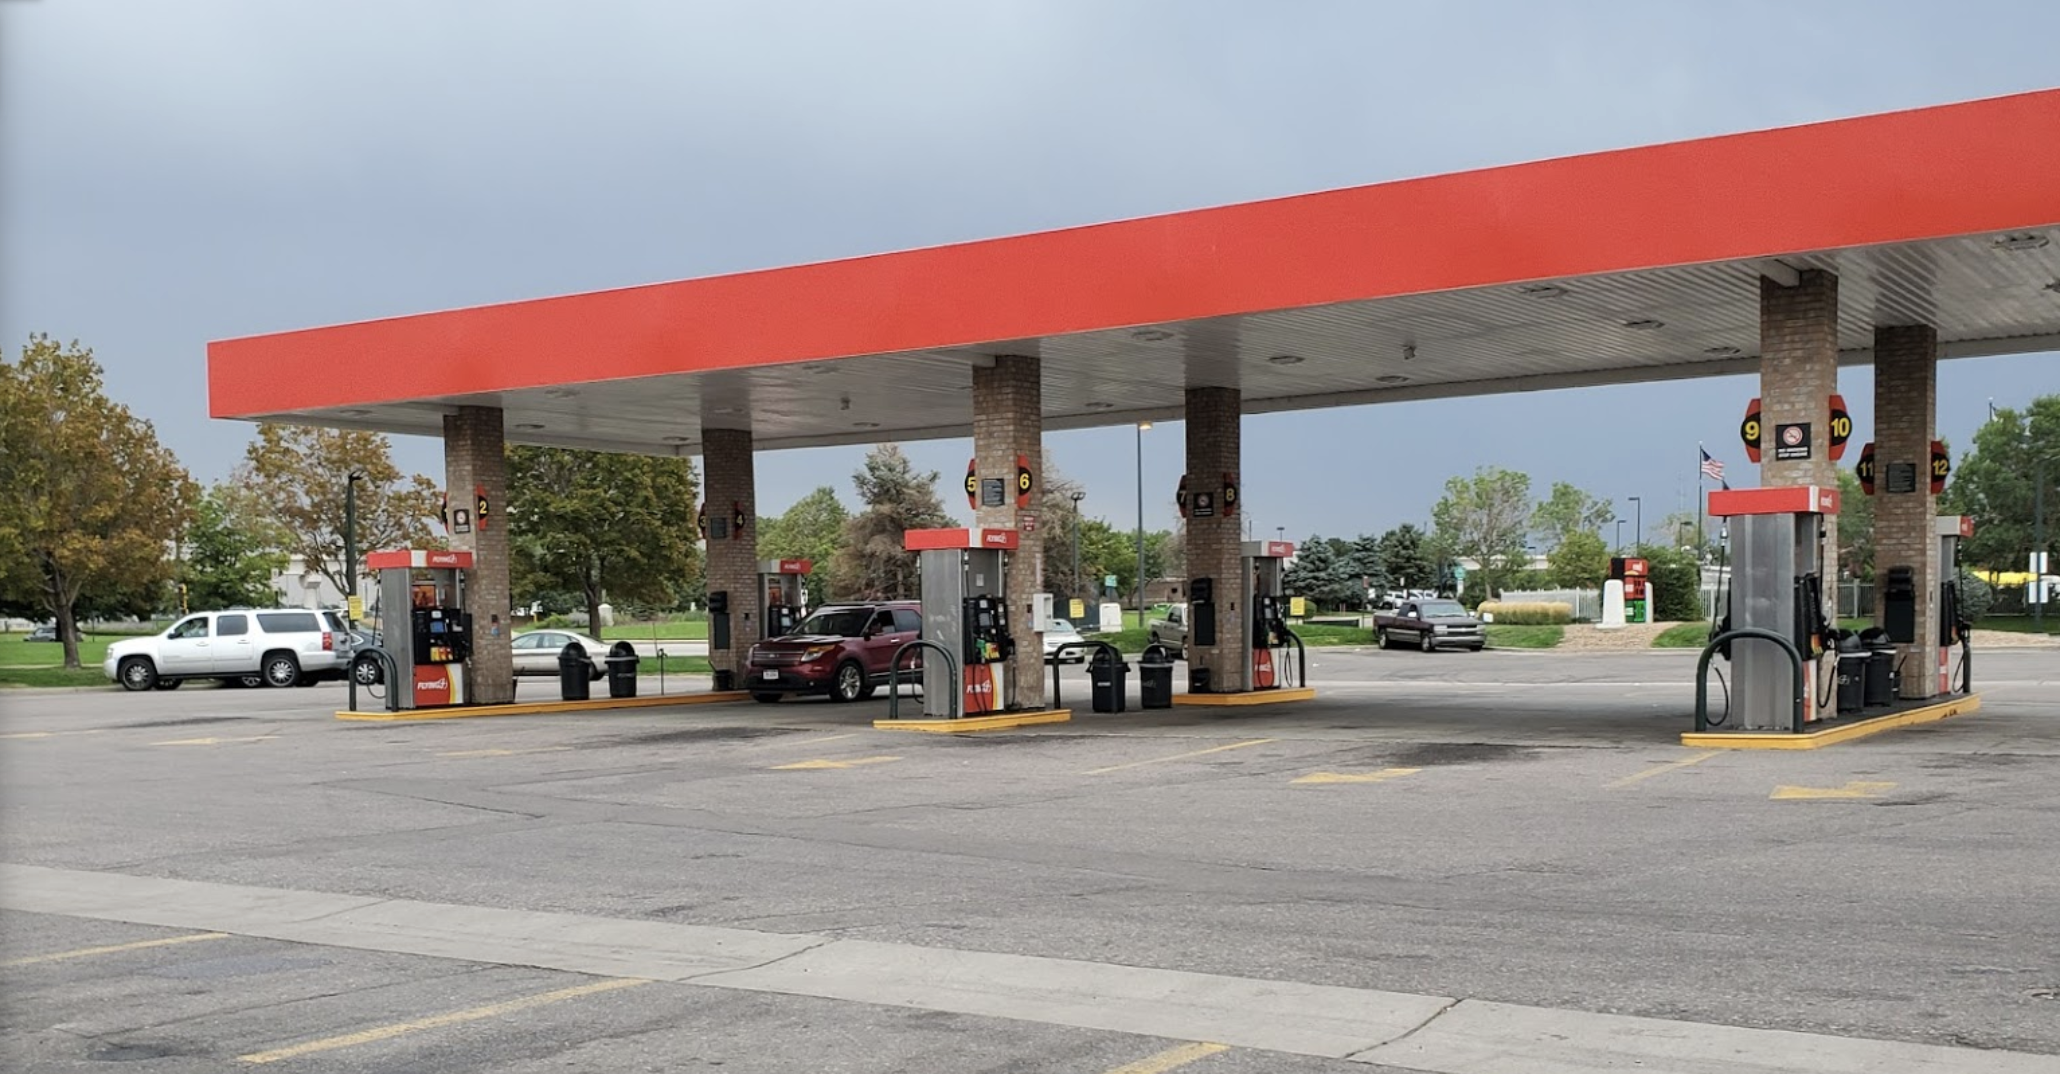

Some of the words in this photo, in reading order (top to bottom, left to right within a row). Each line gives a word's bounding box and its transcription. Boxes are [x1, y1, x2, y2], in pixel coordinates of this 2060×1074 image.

[1745, 421, 1760, 441] 9
[1831, 417, 1850, 437] 10
[1860, 461, 1873, 477] 11
[1933, 459, 1948, 476] 12
[967, 476, 977, 492] 5
[1019, 473, 1030, 490] 6
[1179, 490, 1187, 504] 7
[1226, 488, 1236, 502] 8
[479, 500, 488, 514] 2
[699, 515, 706, 527] 3
[736, 514, 744, 527] 4
